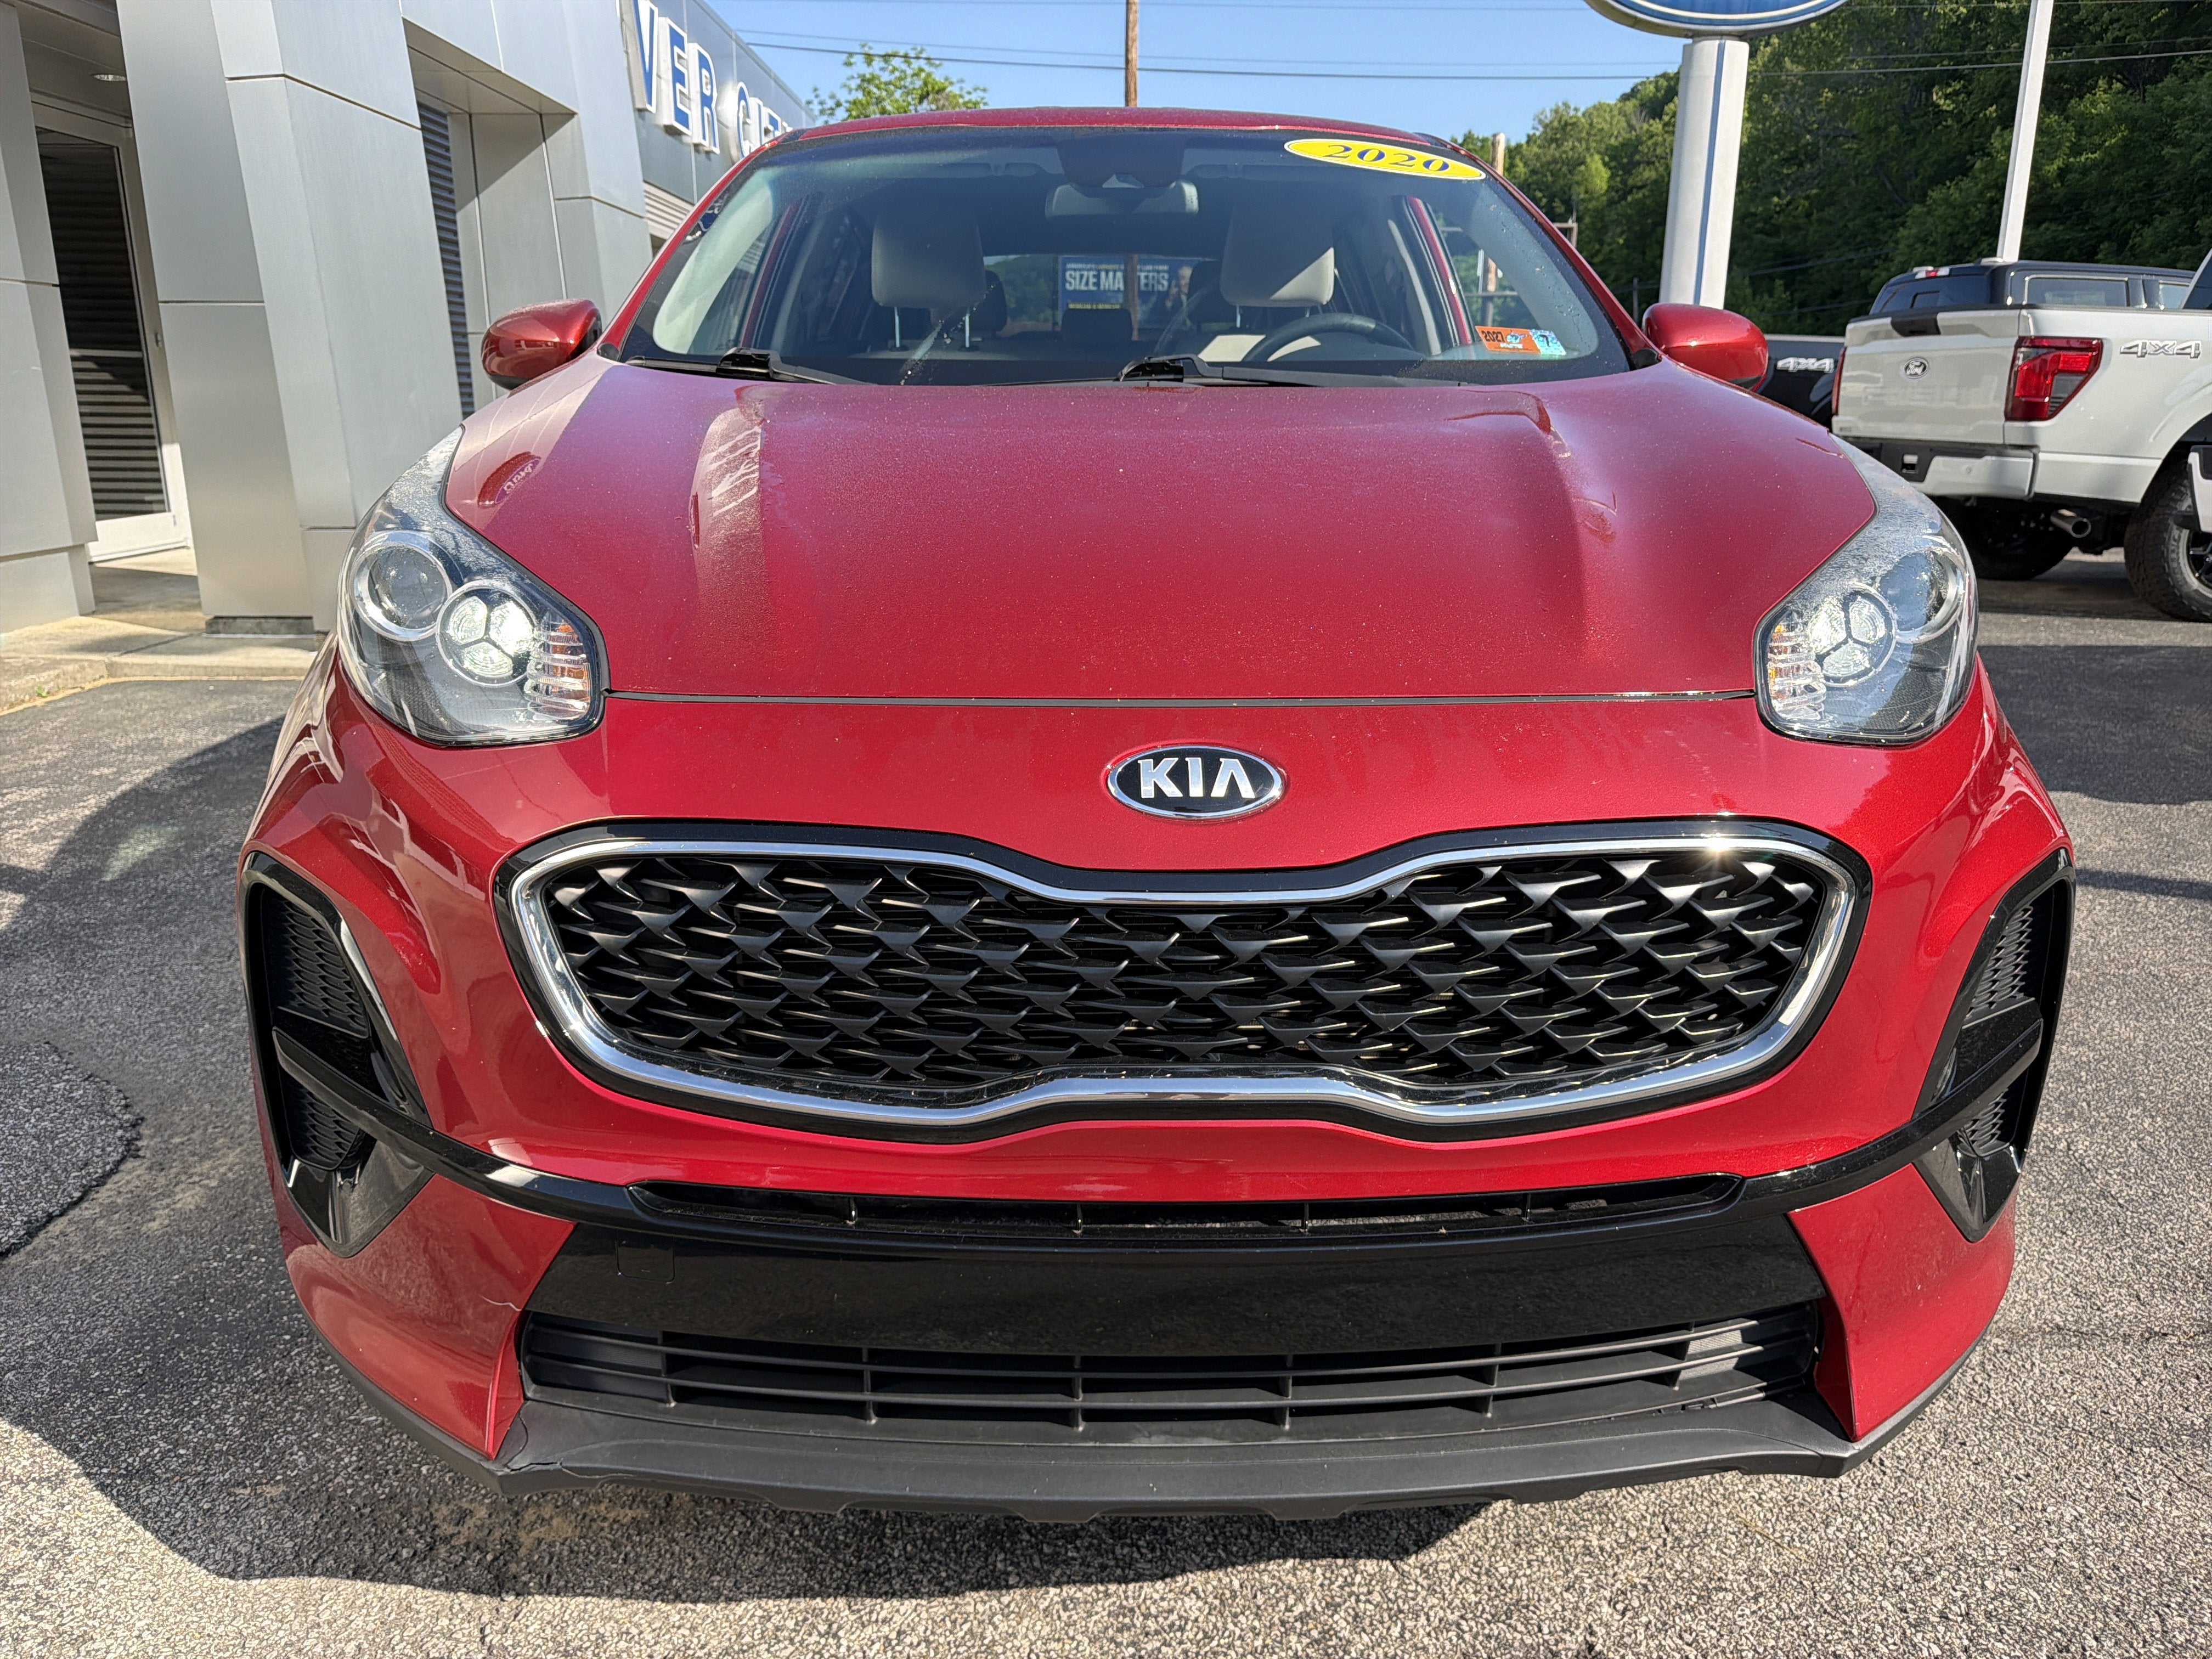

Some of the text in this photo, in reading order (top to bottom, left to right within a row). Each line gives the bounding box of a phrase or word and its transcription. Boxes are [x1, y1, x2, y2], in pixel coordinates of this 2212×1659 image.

[617, 0, 720, 155] VER
[1323, 144, 1449, 172] 2020
[1065, 270, 1169, 291] SIZE MAERS
[1481, 330, 1505, 343] 2027
[1138, 758, 1256, 799] KIA
